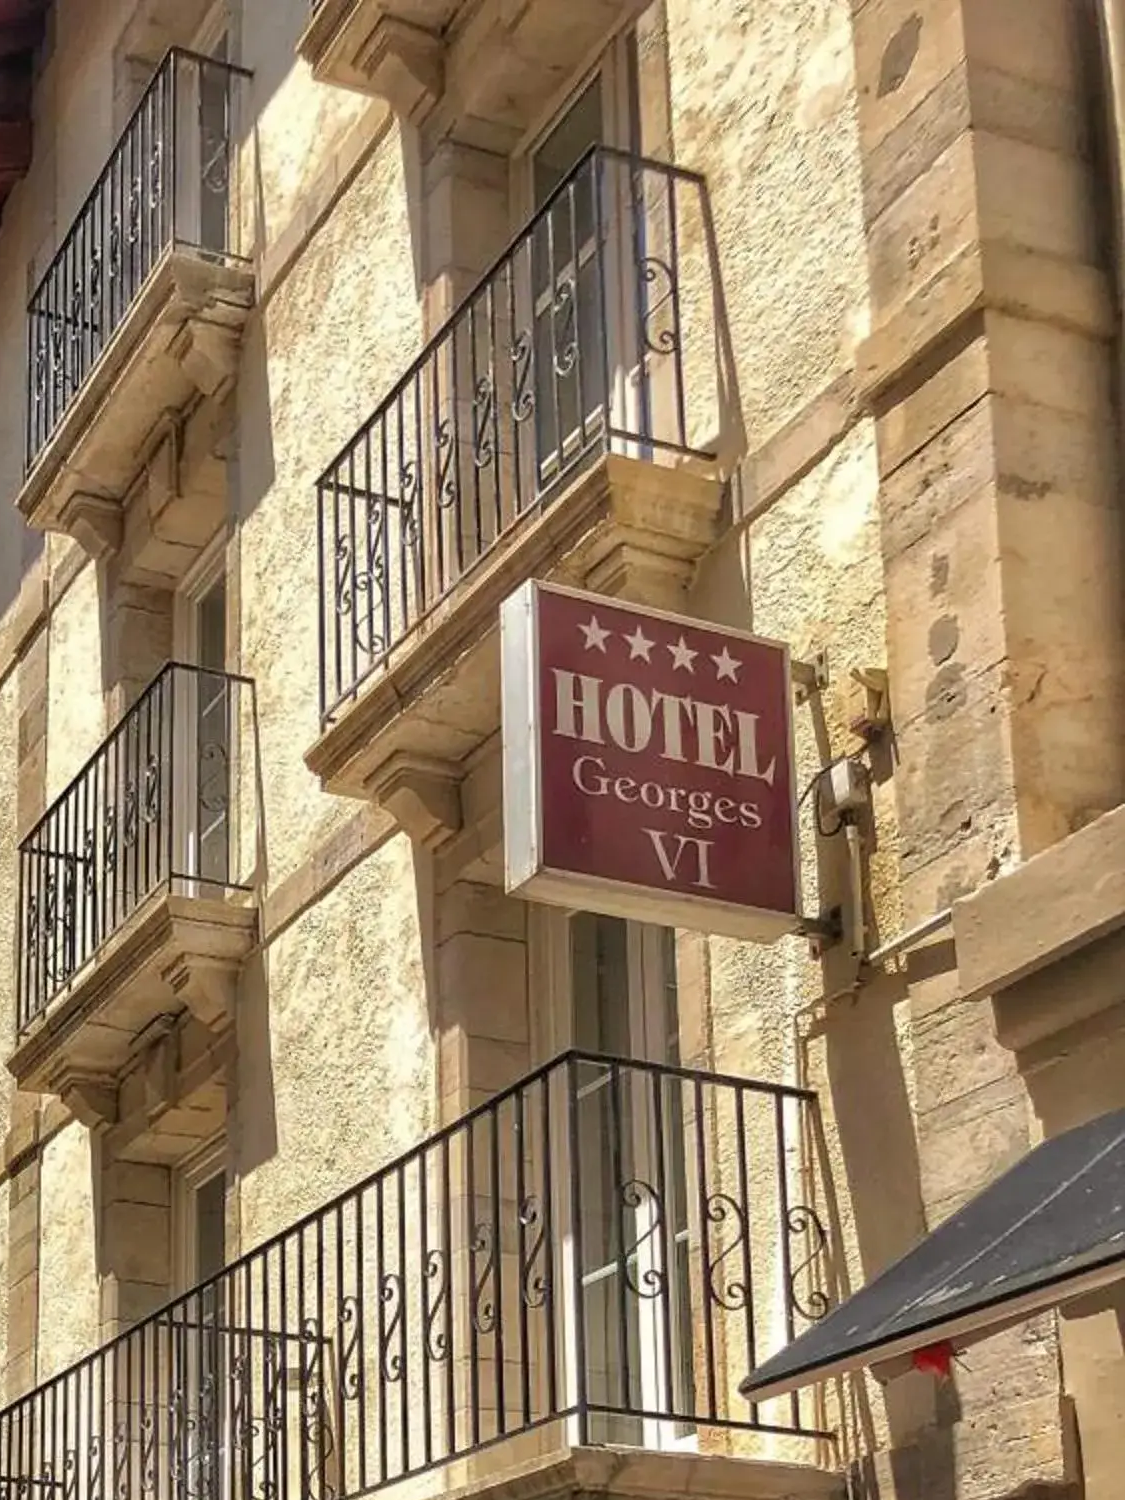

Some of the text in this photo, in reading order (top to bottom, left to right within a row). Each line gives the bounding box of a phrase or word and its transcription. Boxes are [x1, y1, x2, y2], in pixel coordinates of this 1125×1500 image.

[550, 668, 777, 787] HOTEL
[572, 755, 762, 829] Georges
[642, 828, 718, 889] VI
